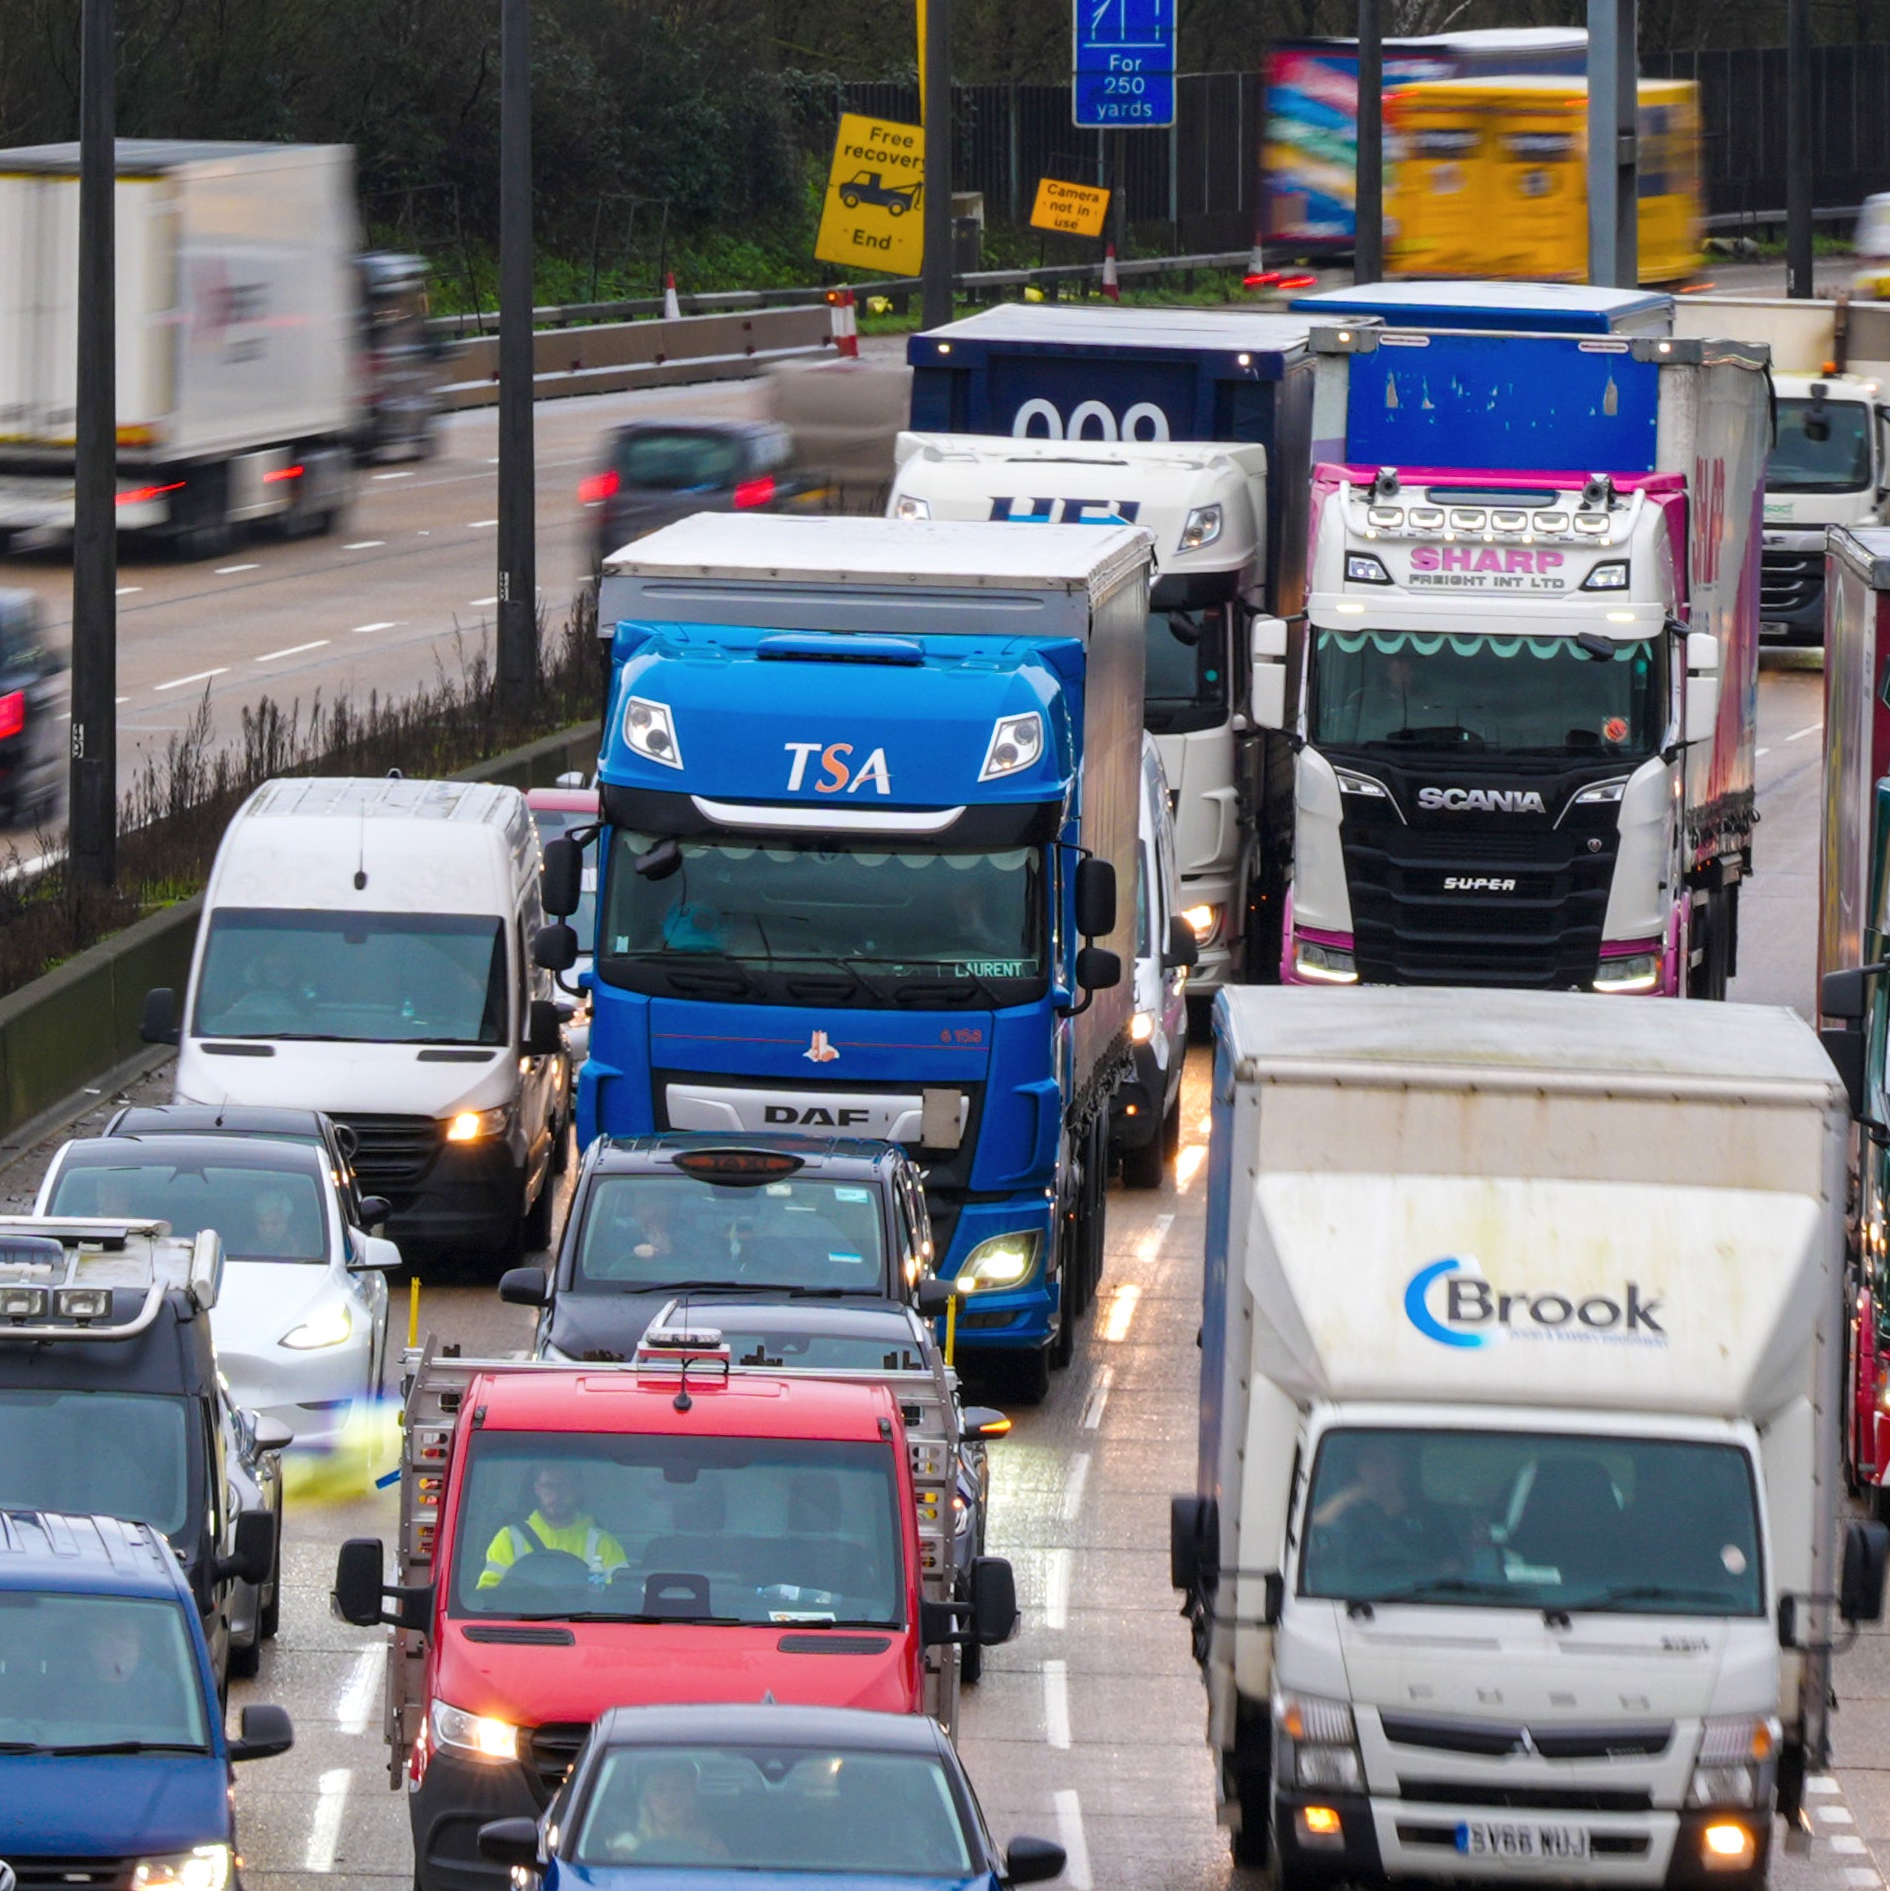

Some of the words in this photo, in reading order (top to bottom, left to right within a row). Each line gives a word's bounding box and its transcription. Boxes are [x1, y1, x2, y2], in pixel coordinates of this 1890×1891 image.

[1110, 54, 1142, 72] For
[1104, 76, 1145, 95] 250
[1096, 100, 1152, 121] yards
[870, 127, 914, 148] Free
[1047, 183, 1099, 203] Camera
[1050, 201, 1073, 214] not
[1077, 204, 1090, 217] in
[1054, 218, 1078, 229] use
[852, 229, 892, 250] End
[1410, 546, 1565, 574] SHARP
[1409, 574, 1487, 587] FREIGHT
[1494, 576, 1524, 588] INT
[1531, 578, 1565, 589] LTD
[784, 743, 892, 795] TSA
[1417, 787, 1546, 813] SCANIA
[1444, 877, 1516, 890] SUPER
[955, 962, 1022, 977] LAURENT
[764, 1106, 869, 1126] DAF
[1447, 1279, 1665, 1332] Brook
